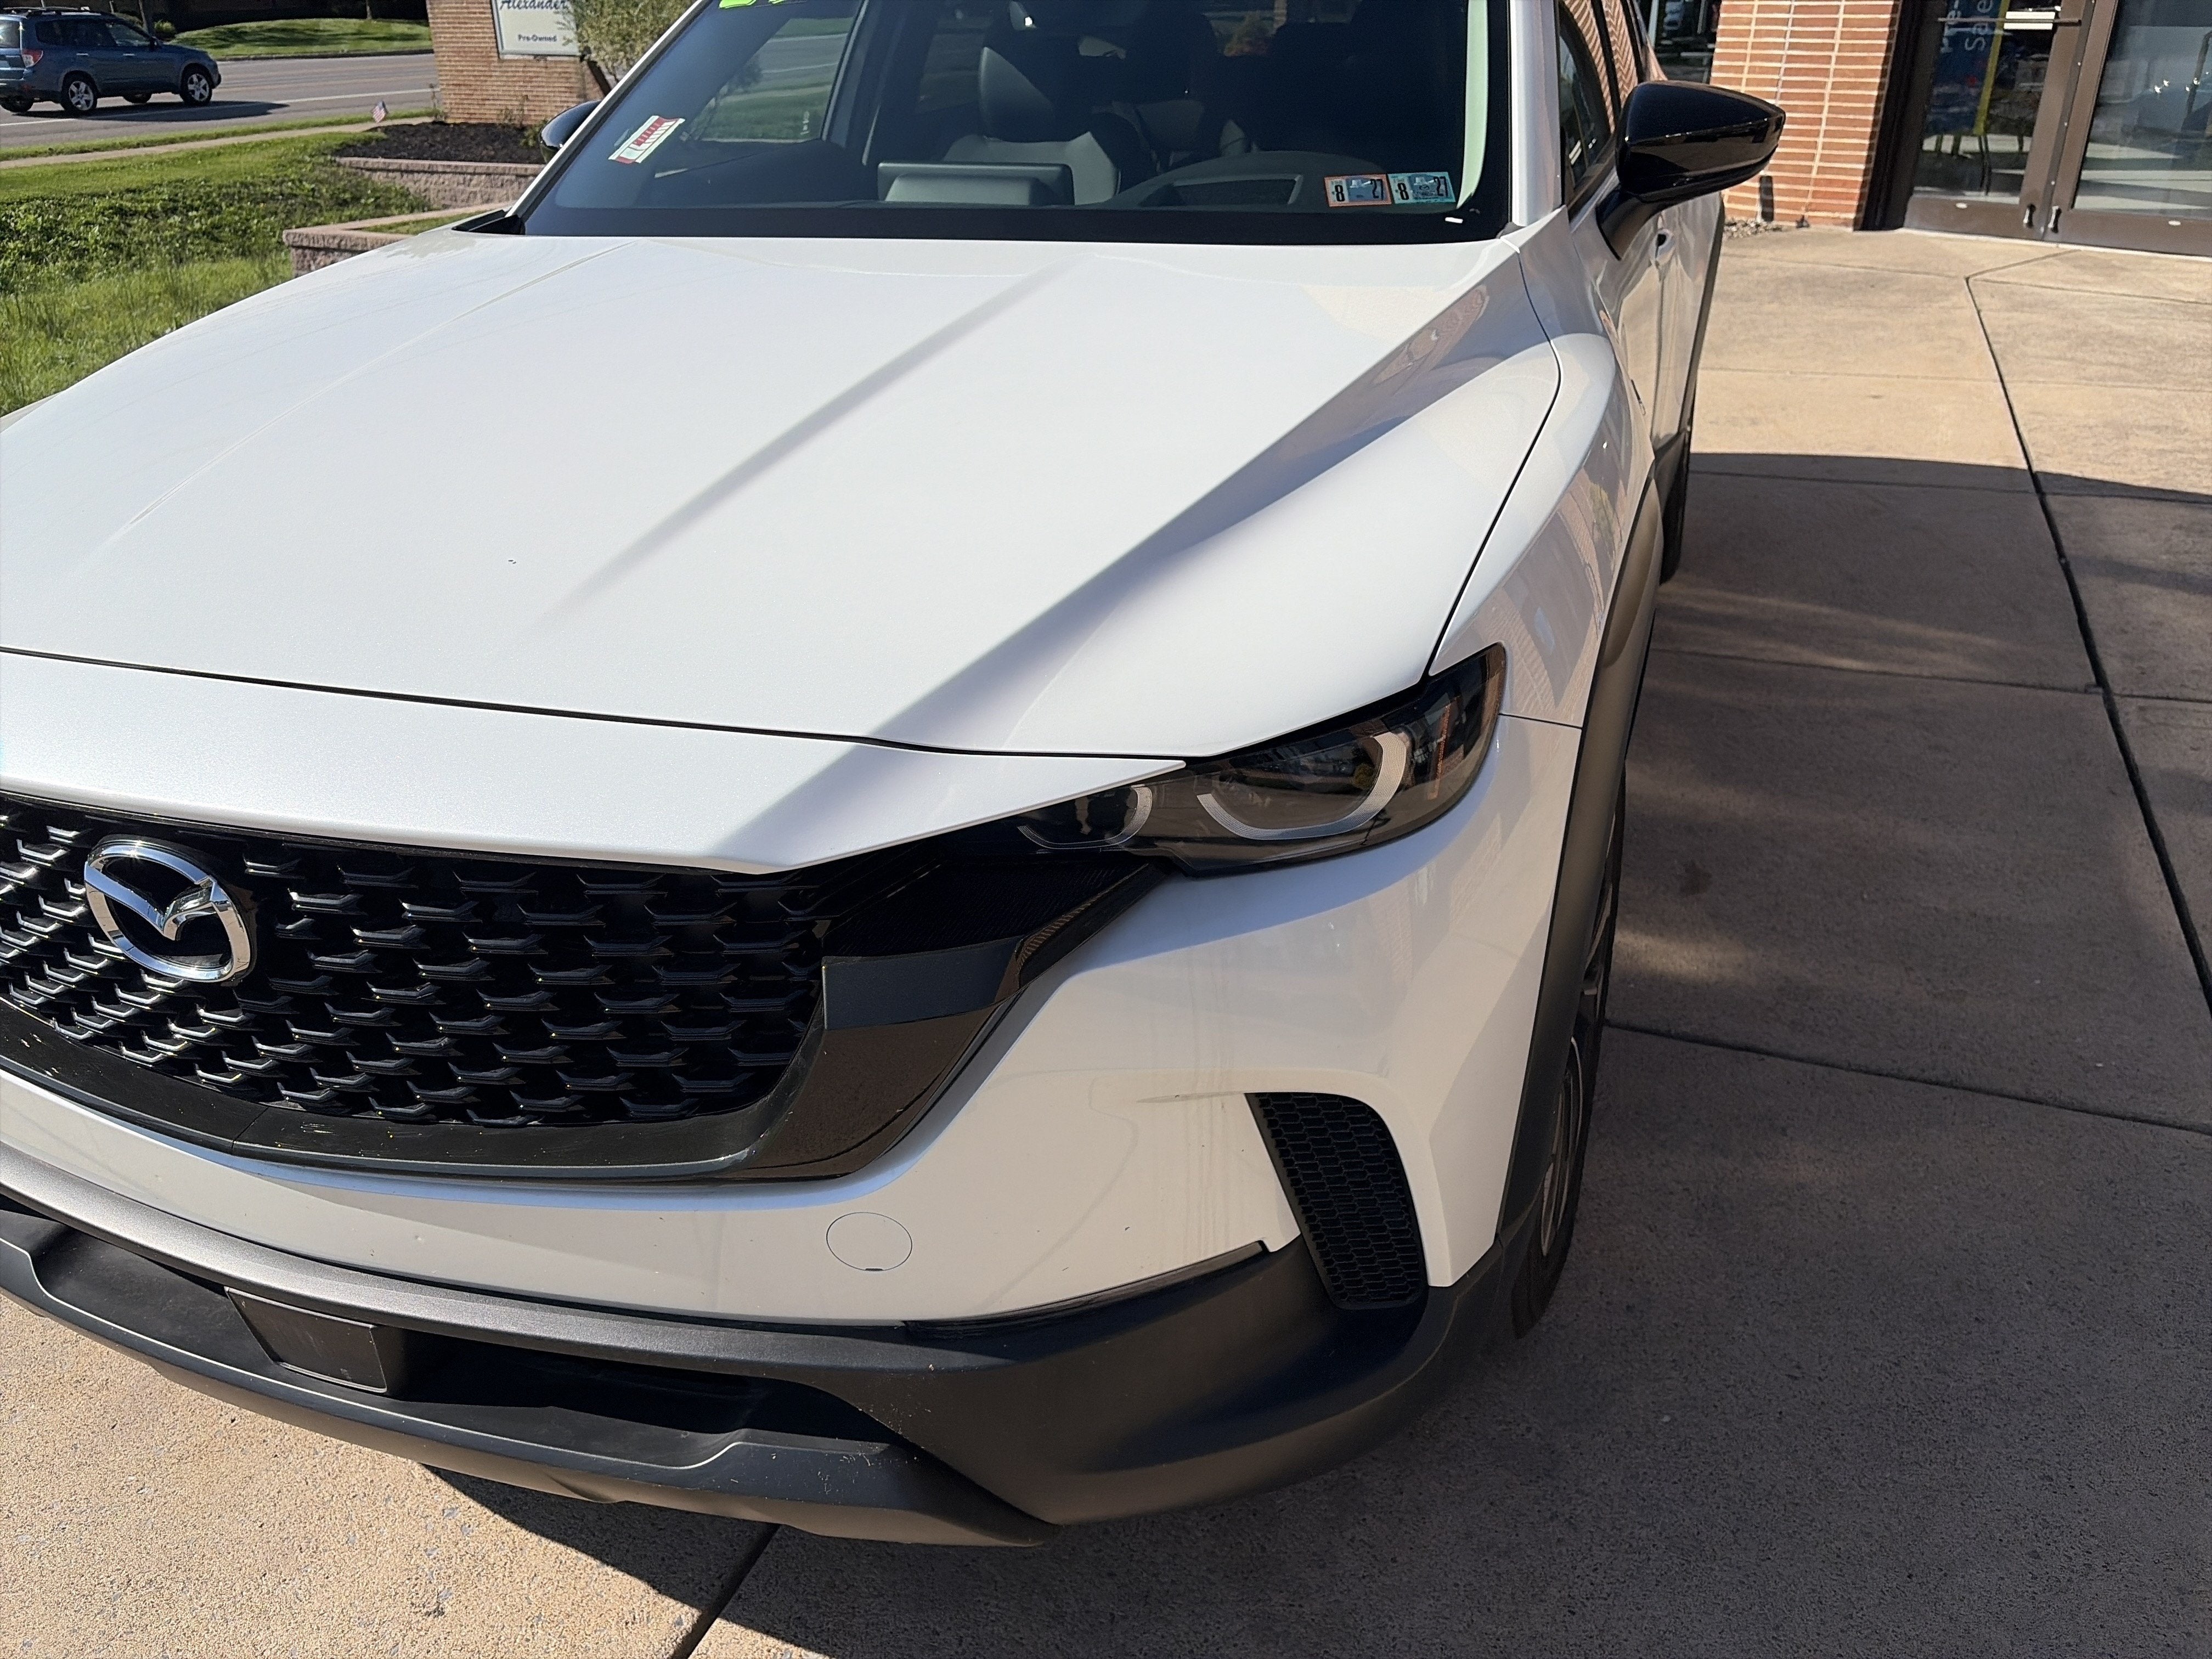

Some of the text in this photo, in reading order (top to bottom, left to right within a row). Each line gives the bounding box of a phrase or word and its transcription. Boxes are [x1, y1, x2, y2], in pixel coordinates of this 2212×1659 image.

[1335, 179, 1384, 202] 8 27
[1397, 176, 1448, 200] 8 27
